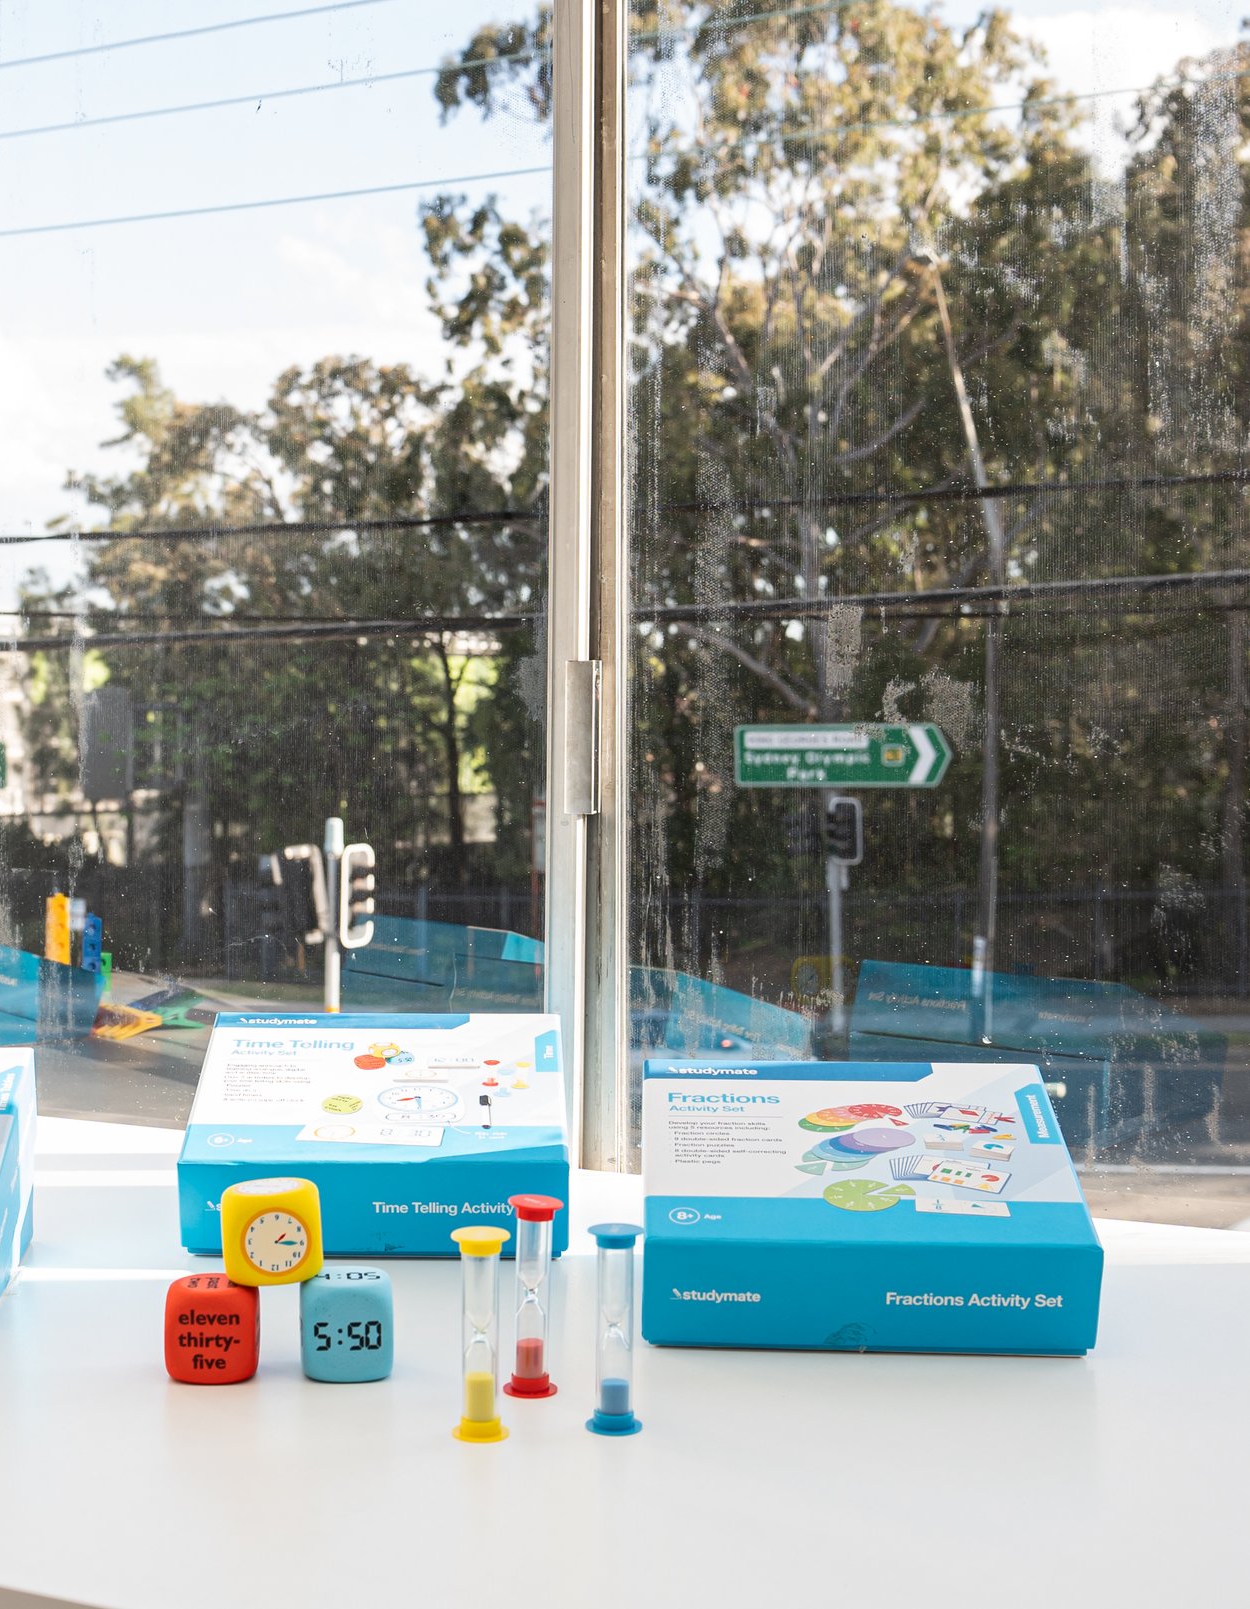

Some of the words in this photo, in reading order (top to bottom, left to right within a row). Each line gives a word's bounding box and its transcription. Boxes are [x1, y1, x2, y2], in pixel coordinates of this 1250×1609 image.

[744, 751, 800, 766] Sydney
[805, 751, 871, 766] Olympic
[786, 766, 827, 780] Park
[249, 1018, 318, 1026] studymate
[232, 1039, 284, 1049] Time
[290, 1039, 354, 1052] Telling
[678, 1067, 758, 1076] studymate
[668, 1092, 780, 1104] Fractions
[669, 1105, 719, 1113] Activity
[372, 1201, 409, 1215] Time
[412, 1201, 458, 1217] Telling
[461, 1202, 515, 1217] Activity
[677, 1211, 694, 1220] 8+
[682, 1289, 761, 1304] studymate
[886, 1291, 964, 1306] Fractions
[967, 1293, 1031, 1310] Activity
[1034, 1294, 1063, 1308] Set
[178, 1309, 240, 1325] eleven
[178, 1332, 240, 1352] thirty-
[314, 1320, 381, 1351] 5:50
[193, 1354, 226, 1370] five
